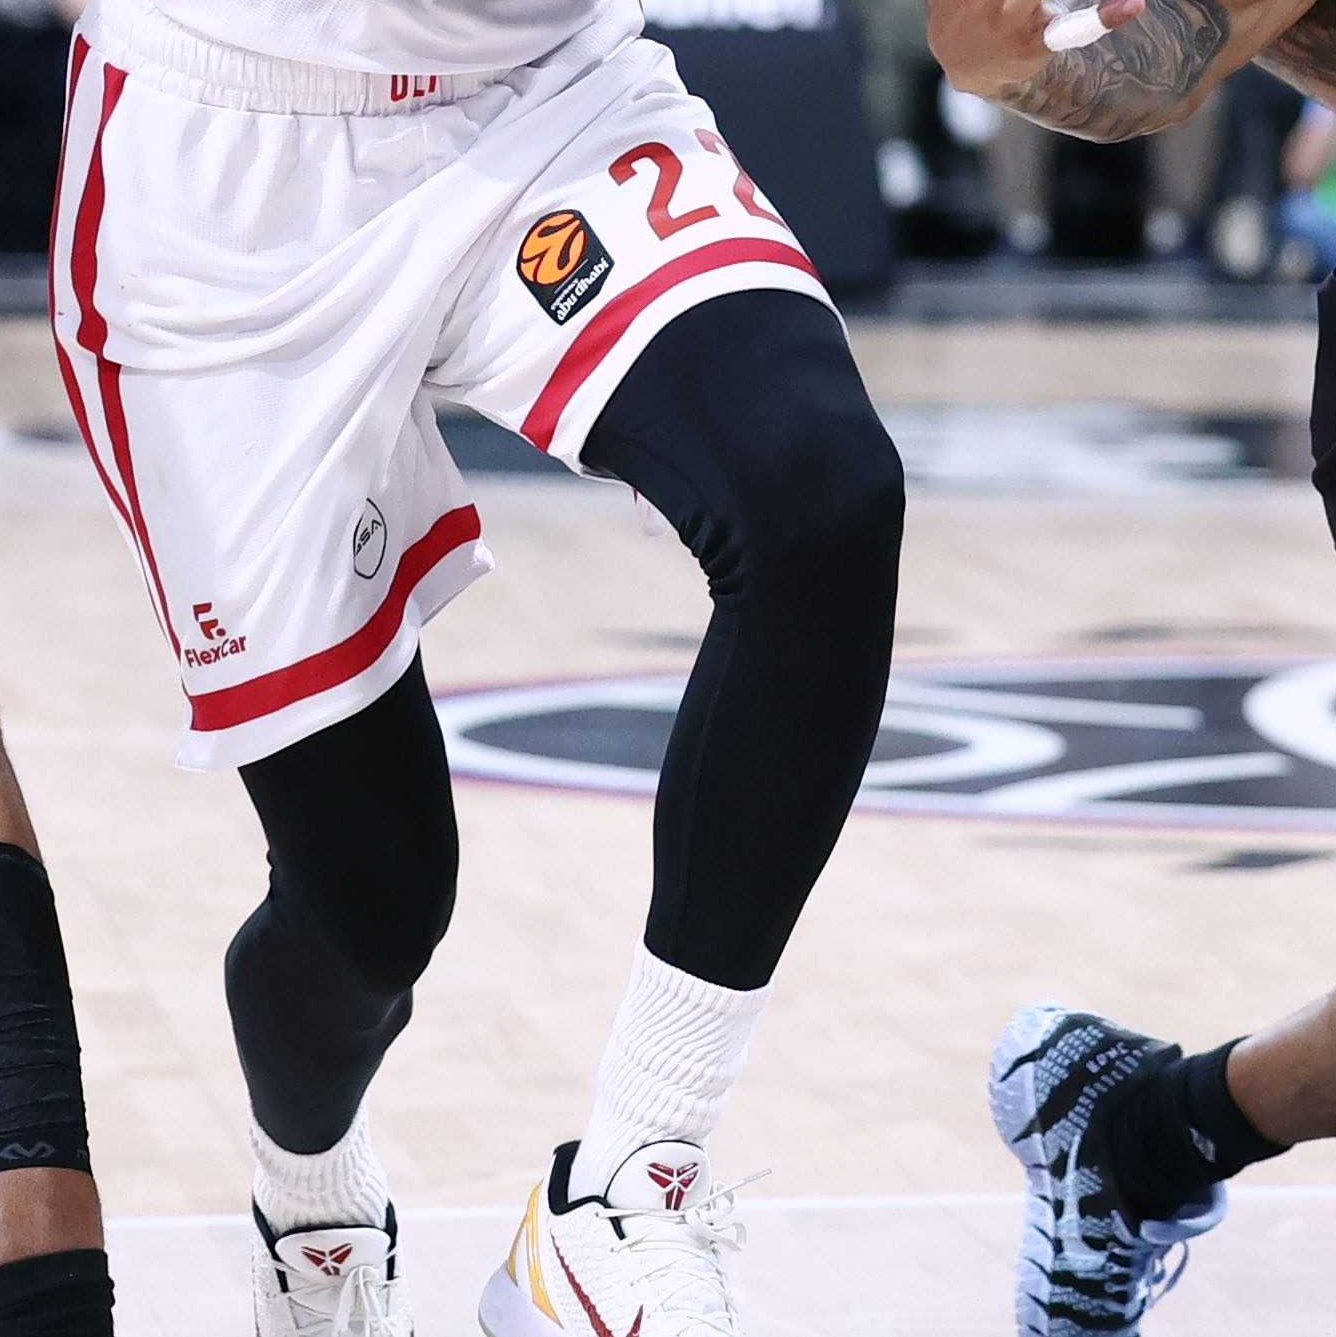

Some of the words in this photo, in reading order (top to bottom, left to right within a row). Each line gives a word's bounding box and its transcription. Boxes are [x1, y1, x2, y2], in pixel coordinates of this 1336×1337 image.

[608, 128, 791, 242] 22
[556, 293, 579, 321] abu
[574, 256, 610, 297] dhabi
[184, 635, 247, 668] FlexCar
